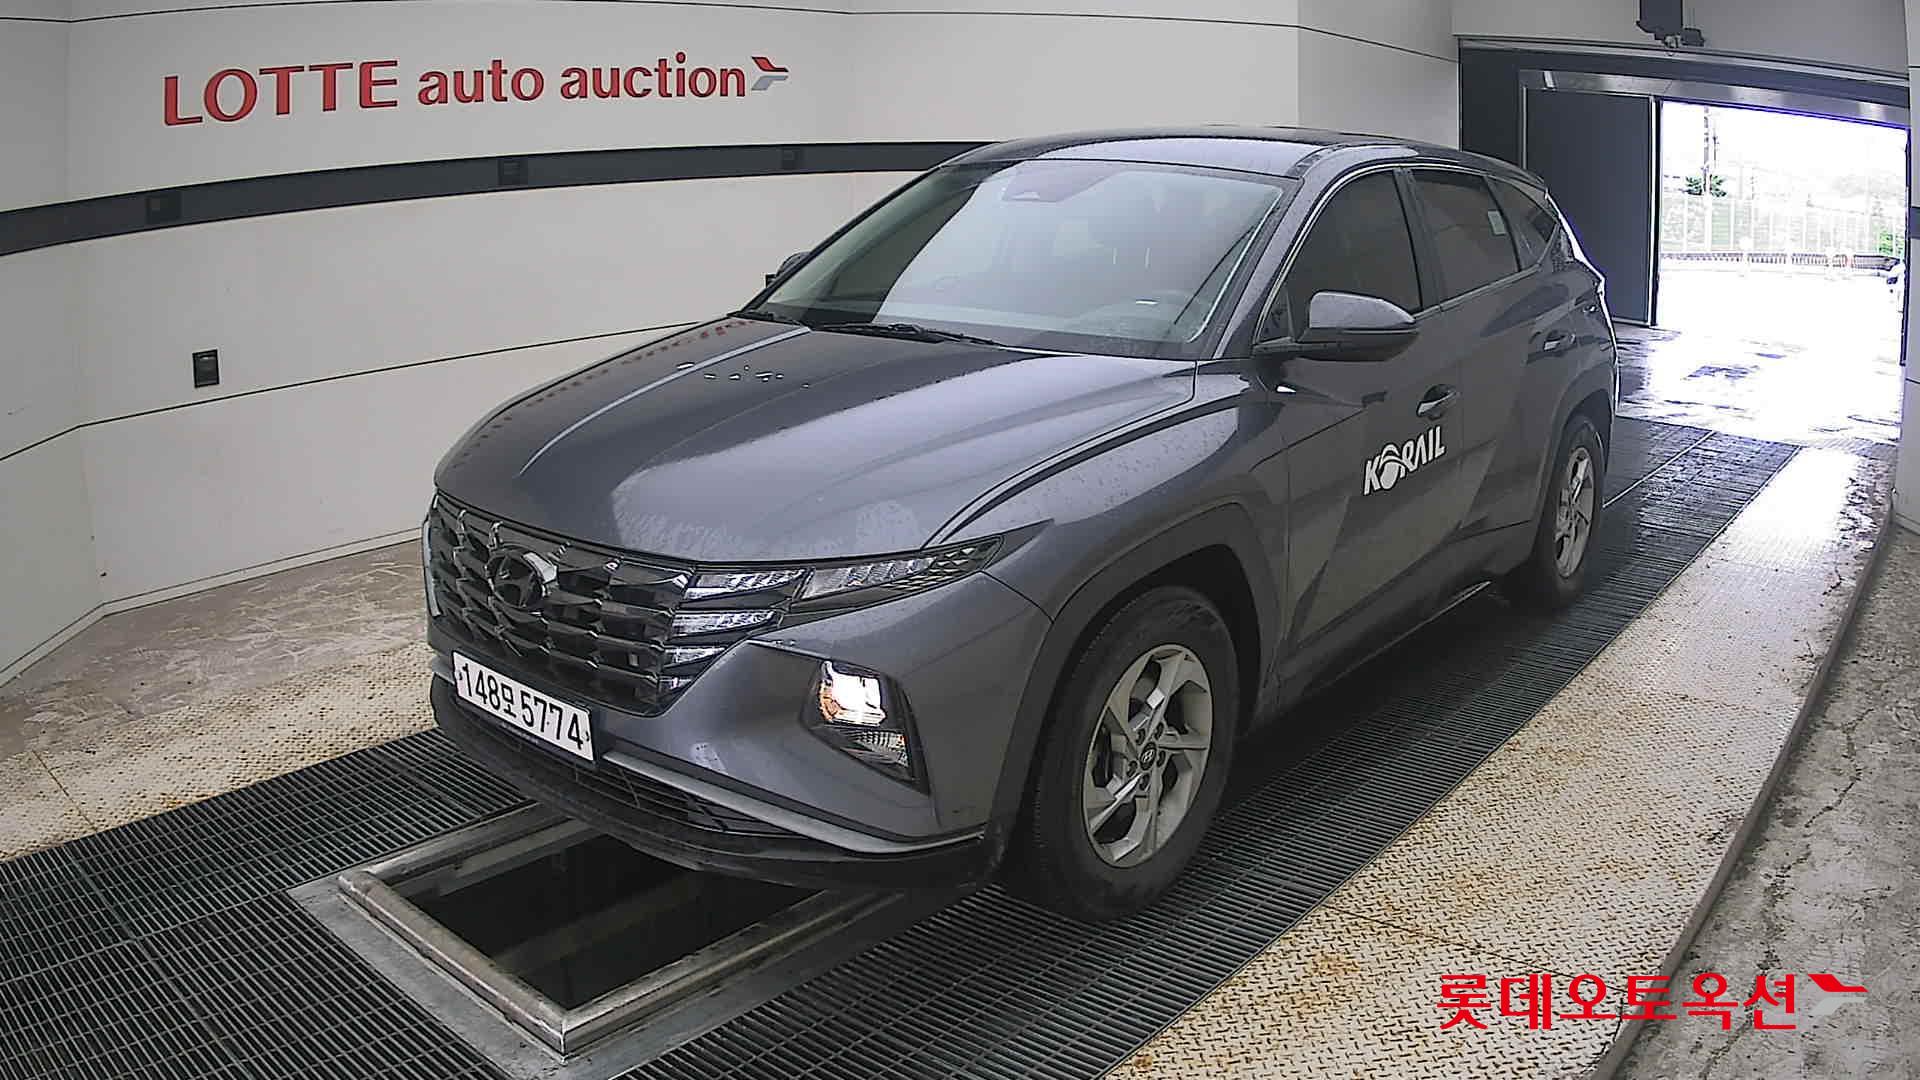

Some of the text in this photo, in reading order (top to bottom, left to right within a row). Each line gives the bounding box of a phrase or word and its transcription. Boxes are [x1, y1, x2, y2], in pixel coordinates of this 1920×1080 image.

[164, 51, 746, 126] LOTTE auto auction
[1364, 425, 1446, 495] KORAIL
